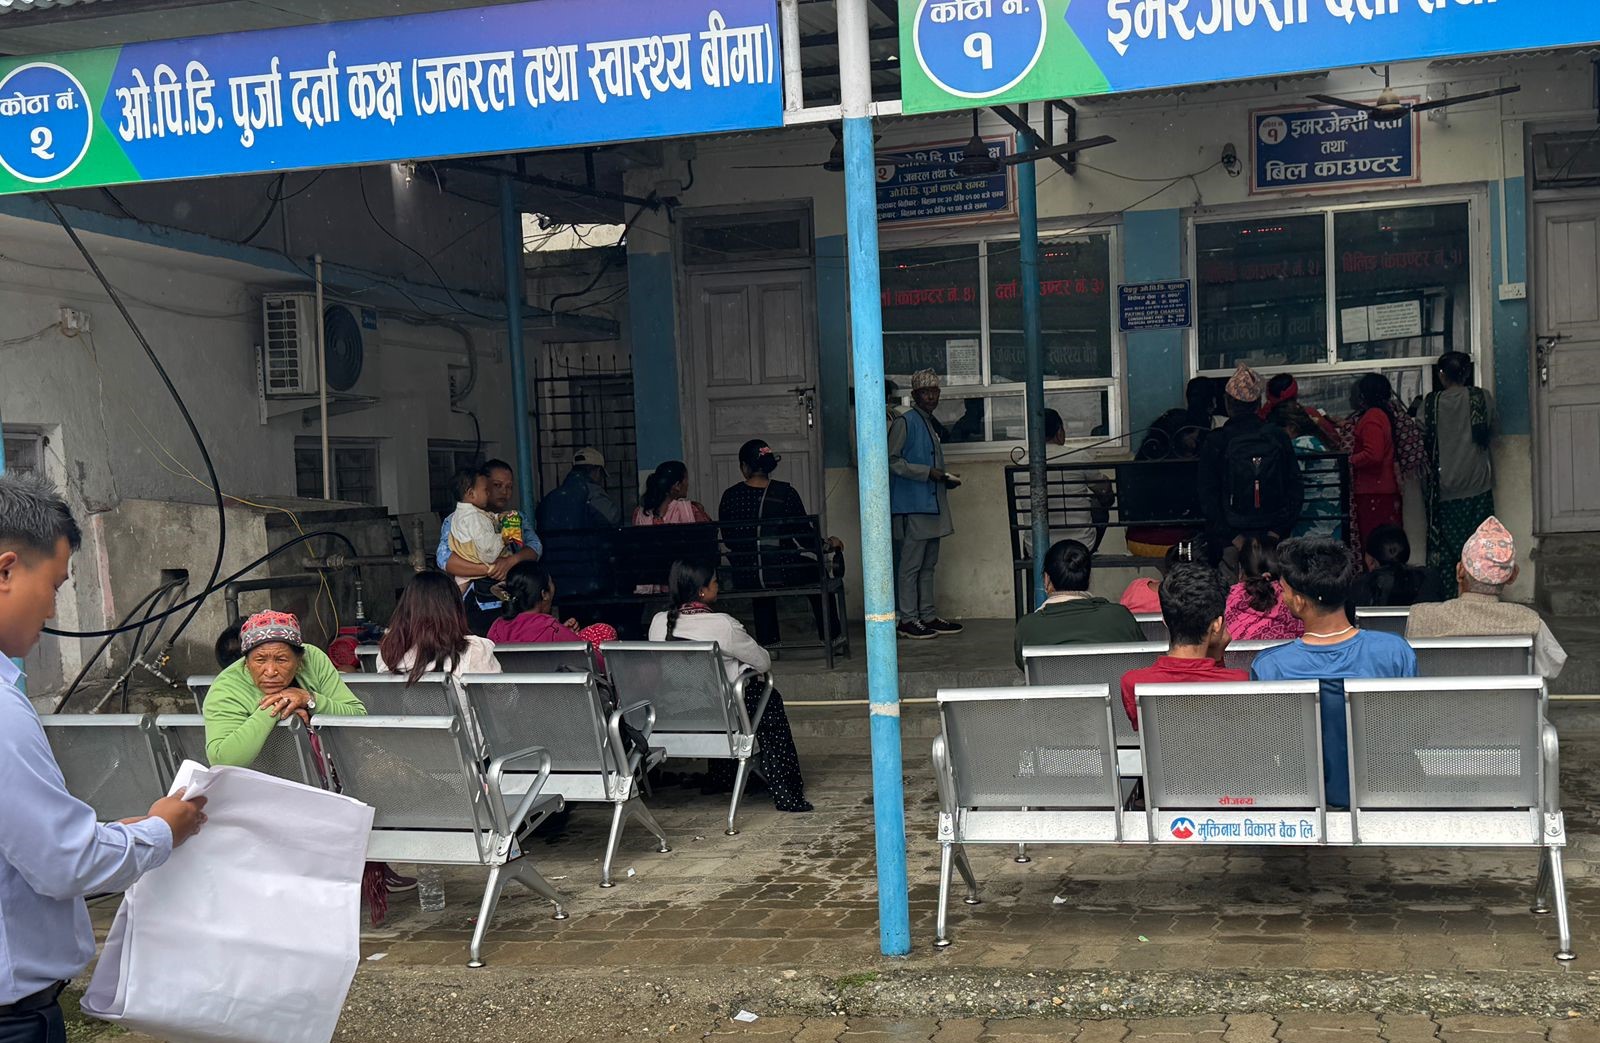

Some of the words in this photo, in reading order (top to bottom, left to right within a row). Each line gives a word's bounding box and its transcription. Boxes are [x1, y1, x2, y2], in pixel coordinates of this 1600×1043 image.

[963, 32, 993, 70] १
[116, 60, 224, 142] ओ.पि.डि.
[228, 55, 283, 148] पुर्जा
[289, 50, 340, 130] दर्ता
[346, 62, 402, 126] कक्ष
[412, 51, 516, 116] (जनरल
[522, 45, 579, 108] तथा
[586, 33, 692, 104] स्वास्थ्य
[699, 9, 773, 88] बीमा)
[0, 92, 50, 116] कोठा
[55, 87, 79, 110] नं.
[30, 127, 55, 160] २
[1321, 141, 1346, 154] तथा
[1266, 160, 1308, 181] बिल
[1314, 156, 1403, 177] काउण्टर
[1198, 819, 1240, 841] मुक्तिनाथ
[1245, 818, 1275, 837] विकास
[1280, 819, 1296, 838] बैंक
[1300, 819, 1316, 838] लि.
